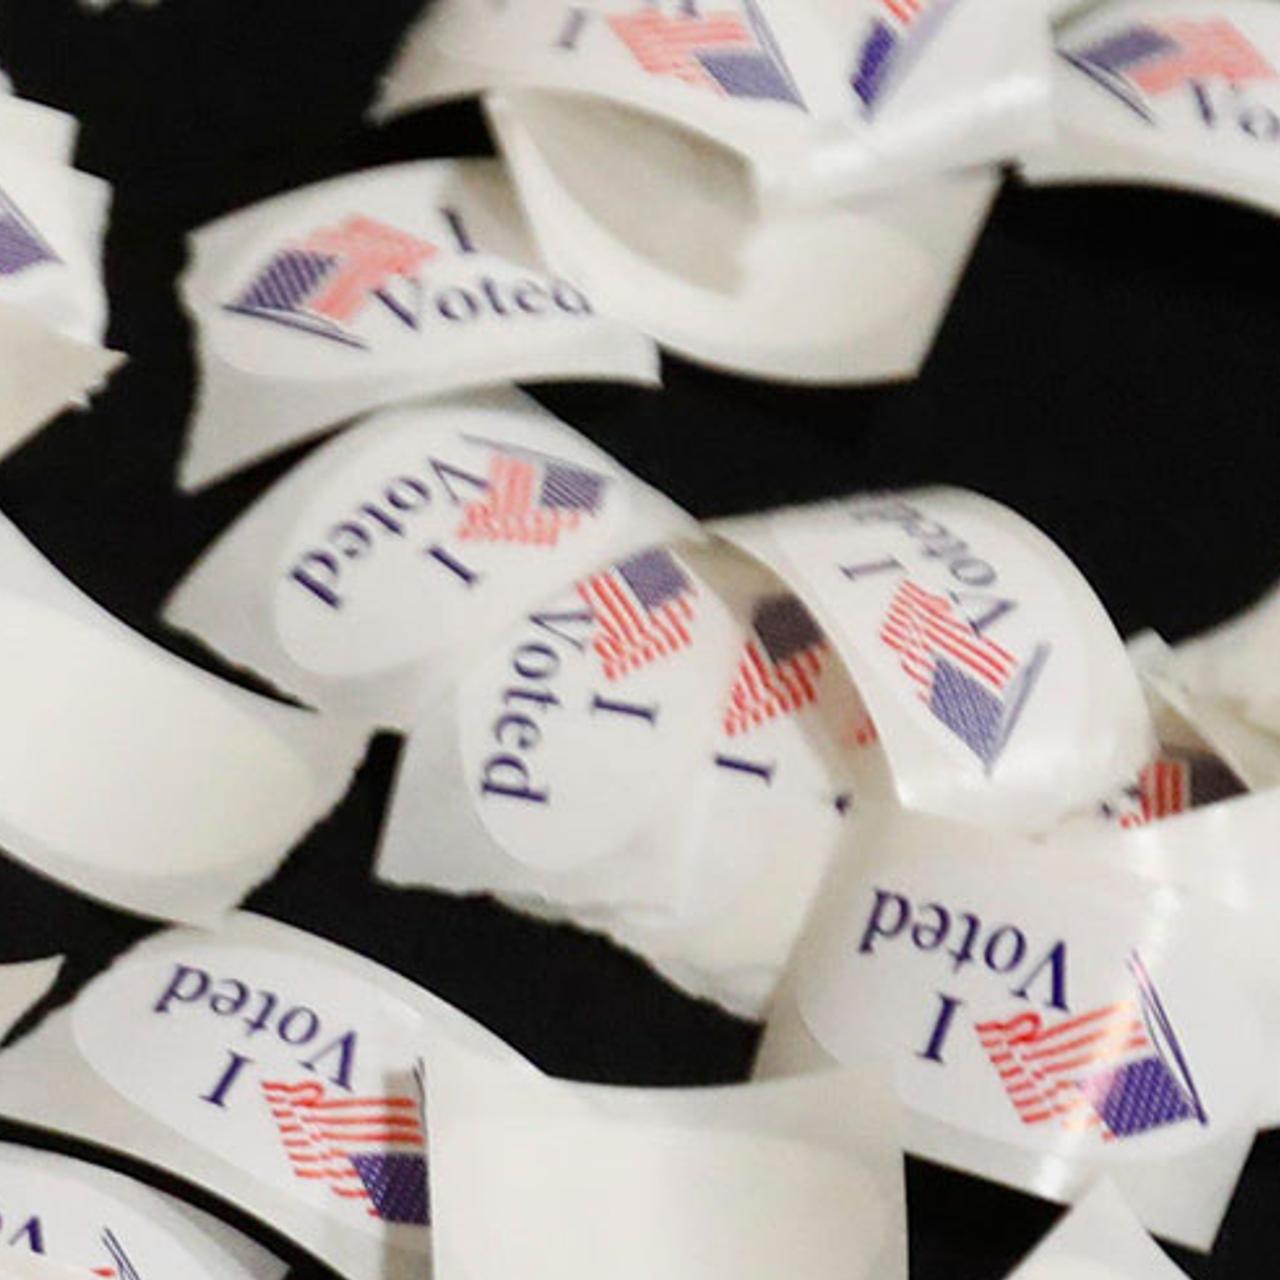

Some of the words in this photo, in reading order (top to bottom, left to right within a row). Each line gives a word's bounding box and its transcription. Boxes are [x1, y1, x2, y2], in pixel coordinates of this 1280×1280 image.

[440, 204, 476, 253] I
[289, 456, 490, 612] Voted
[425, 540, 478, 586] I
[480, 608, 594, 804] Voted
[590, 693, 658, 727] I
[858, 886, 1071, 1012] Voted
[151, 962, 361, 1092] Voted
[914, 994, 962, 1064] I
[198, 1050, 250, 1109] I
